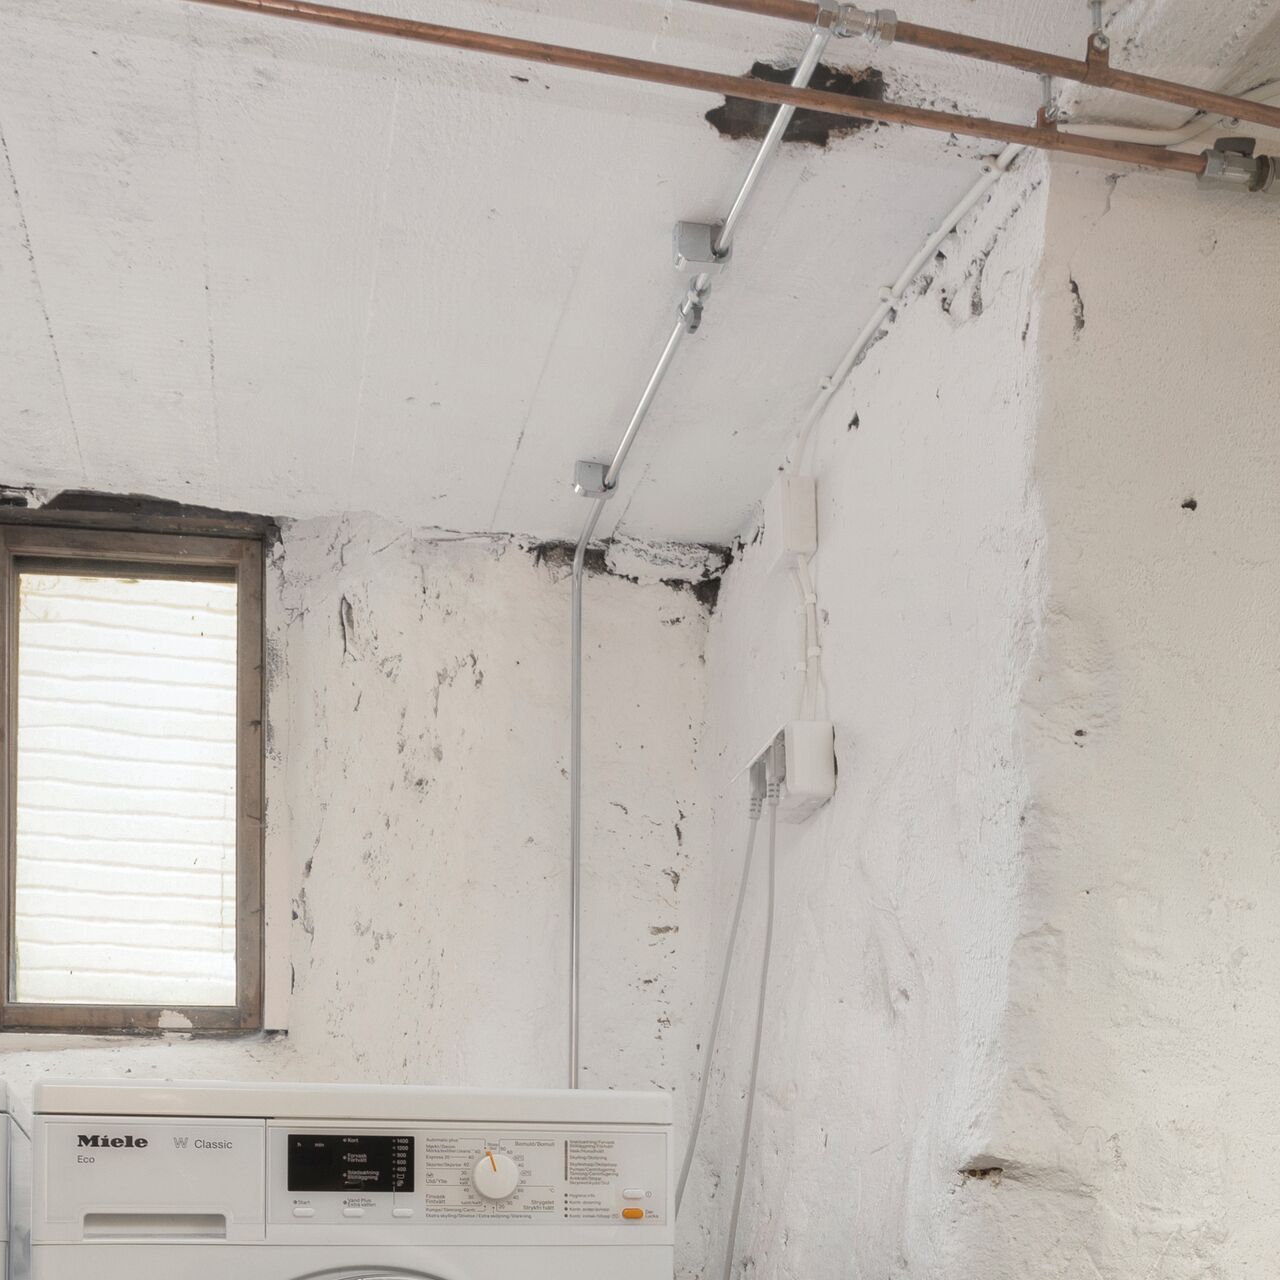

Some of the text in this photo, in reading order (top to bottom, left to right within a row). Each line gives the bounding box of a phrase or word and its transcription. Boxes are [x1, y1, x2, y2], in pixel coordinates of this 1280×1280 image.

[77, 1135, 148, 1148] Miele
[173, 1137, 233, 1149] W Classic
[77, 1155, 95, 1164] Eco
